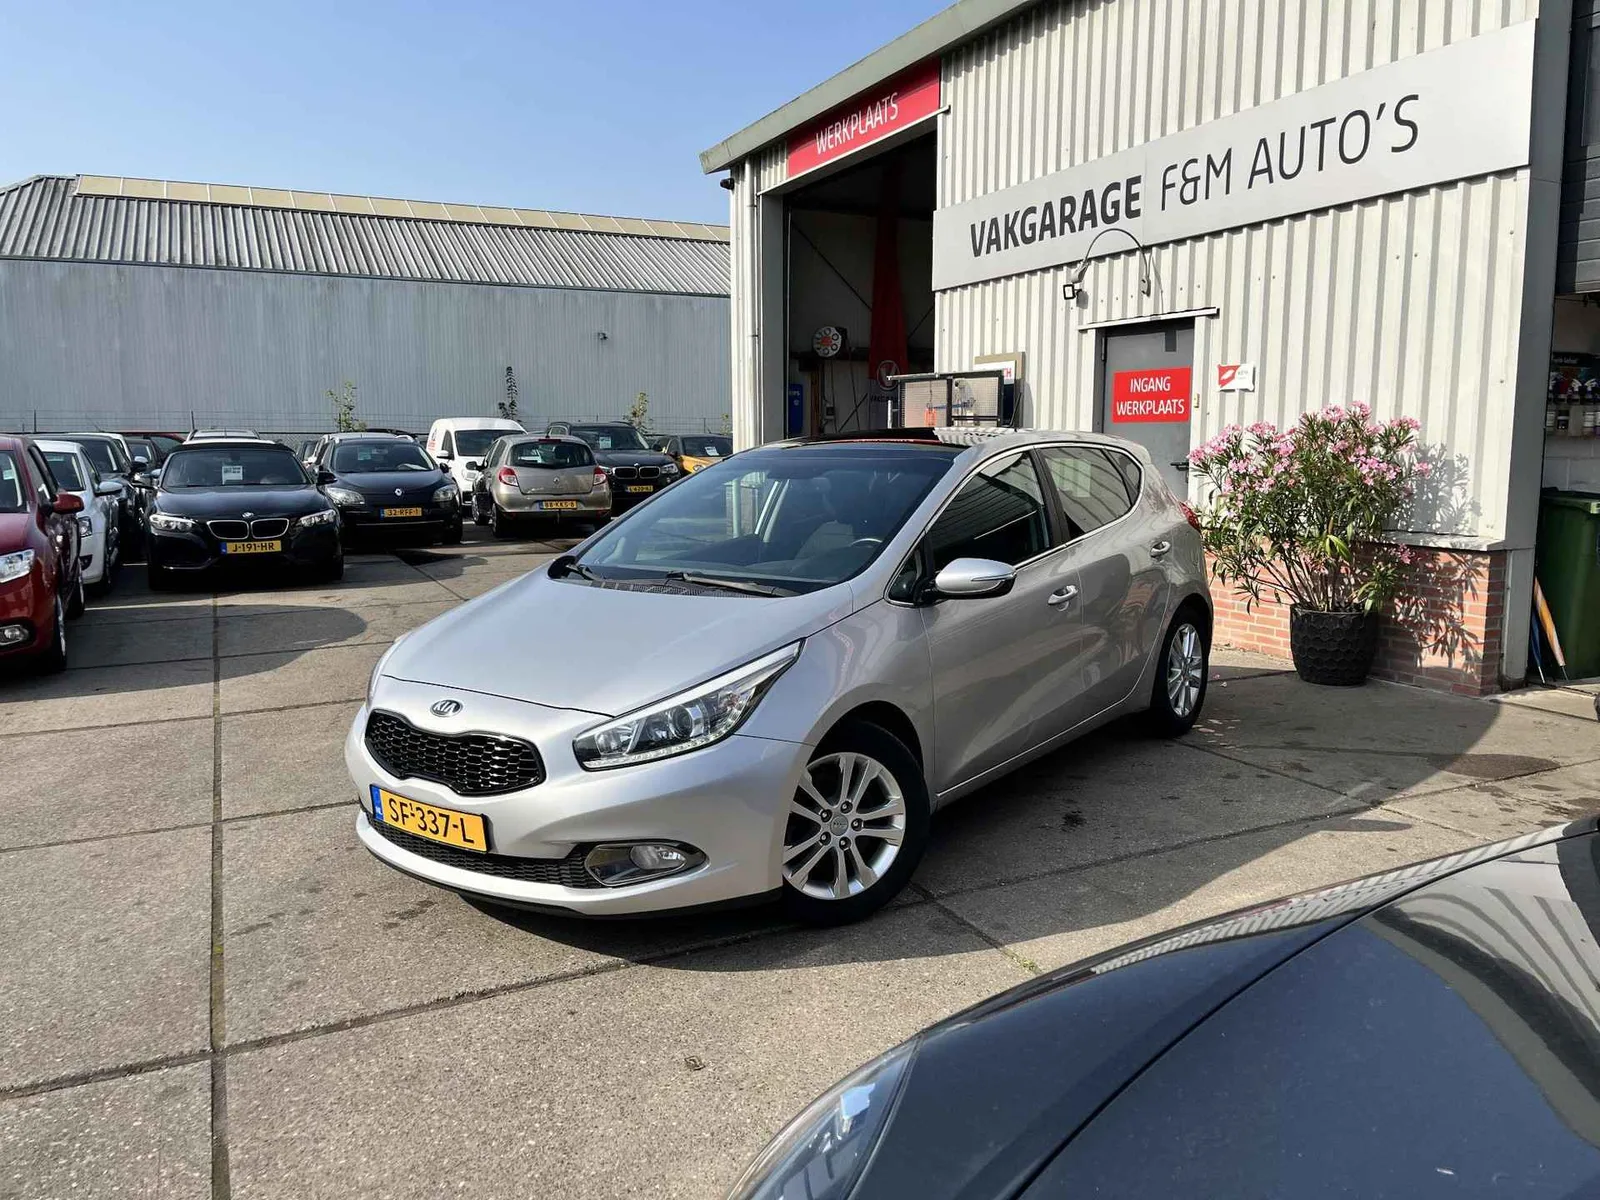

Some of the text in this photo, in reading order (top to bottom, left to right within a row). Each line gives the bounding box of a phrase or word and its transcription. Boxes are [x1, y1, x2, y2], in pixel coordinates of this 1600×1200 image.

[815, 92, 899, 154] WERKPLAATS
[969, 94, 1419, 258] VAKGARAGE F&M AUTO'S
[1130, 376, 1171, 393] INGANG
[1116, 399, 1185, 416] WERKPLAATS
[232, 542, 275, 552] J-191-HR
[432, 700, 458, 714] KIA
[388, 798, 475, 844] SF-337-L
